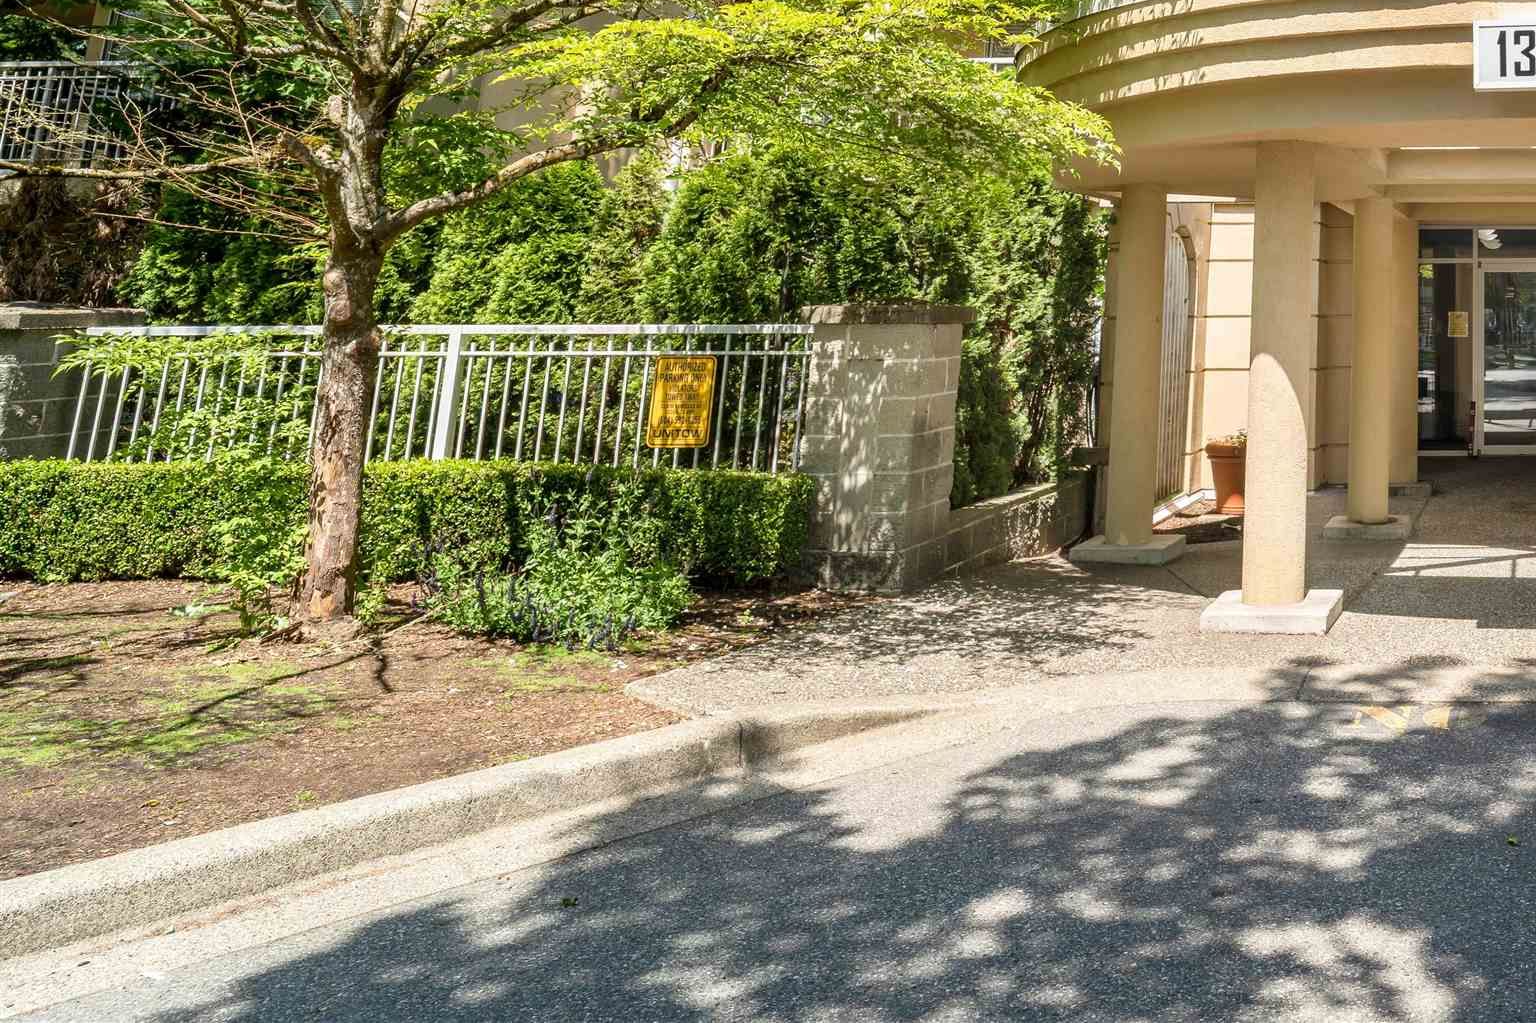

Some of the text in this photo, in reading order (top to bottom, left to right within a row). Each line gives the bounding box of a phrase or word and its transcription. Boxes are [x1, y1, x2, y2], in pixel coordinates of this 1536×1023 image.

[664, 361, 706, 371] AUTHORIZED
[659, 373, 689, 383] PARKING
[653, 429, 703, 437] UNITOW
